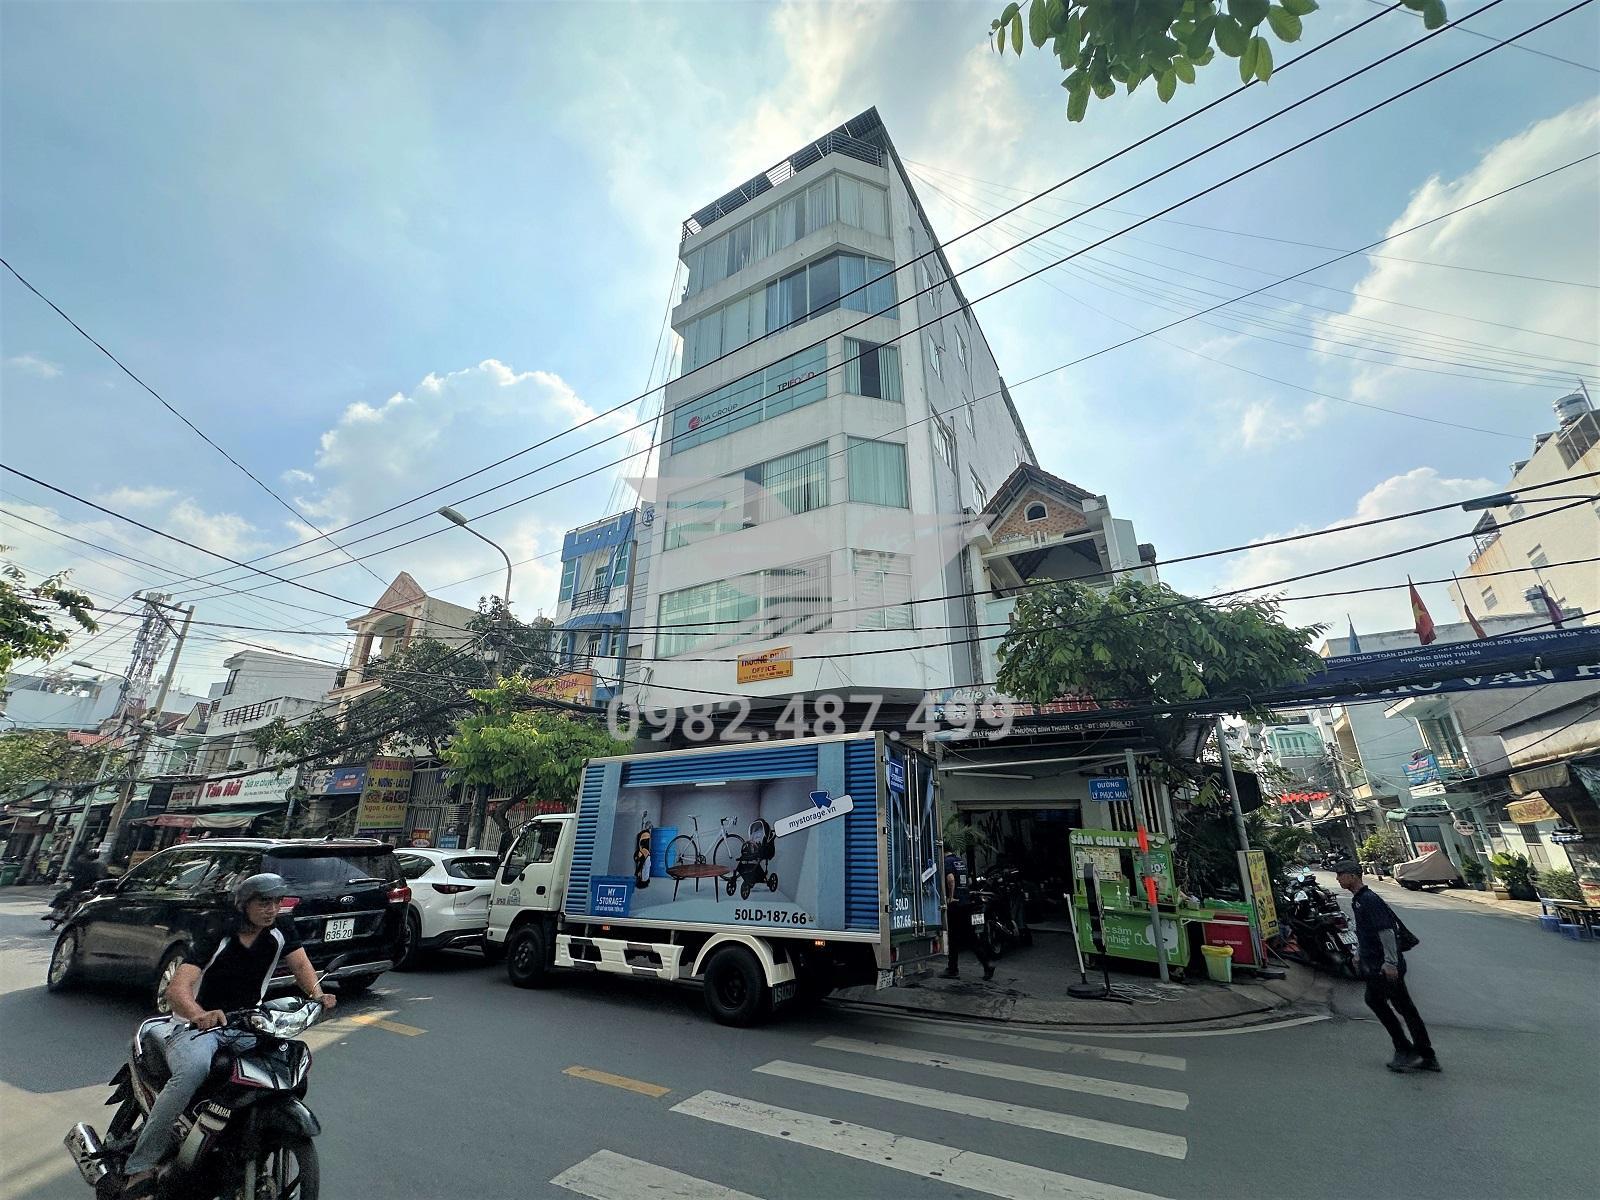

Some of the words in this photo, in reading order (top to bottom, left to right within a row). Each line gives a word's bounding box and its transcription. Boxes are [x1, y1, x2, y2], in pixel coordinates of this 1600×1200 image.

[711, 403, 738, 418] GROUP
[1433, 652, 1452, 660] BÌNH
[752, 665, 777, 673] OFFICE
[1097, 781, 1119, 789] ĐƯỜNG
[789, 806, 837, 829] mystorage.vn
[1070, 832, 1094, 845] SÂM
[1095, 836, 1127, 847] CHILL
[608, 888, 616, 896] MY
[599, 896, 623, 906] STORAGE
[895, 898, 909, 911] 50LD
[734, 908, 807, 925] 50LD-187.66
[893, 914, 911, 929] 187.66
[332, 920, 348, 930] 51F
[1111, 926, 1132, 935] sâm
[1106, 934, 1131, 947] nhiệt
[208, 1103, 232, 1118] YAMAHA
